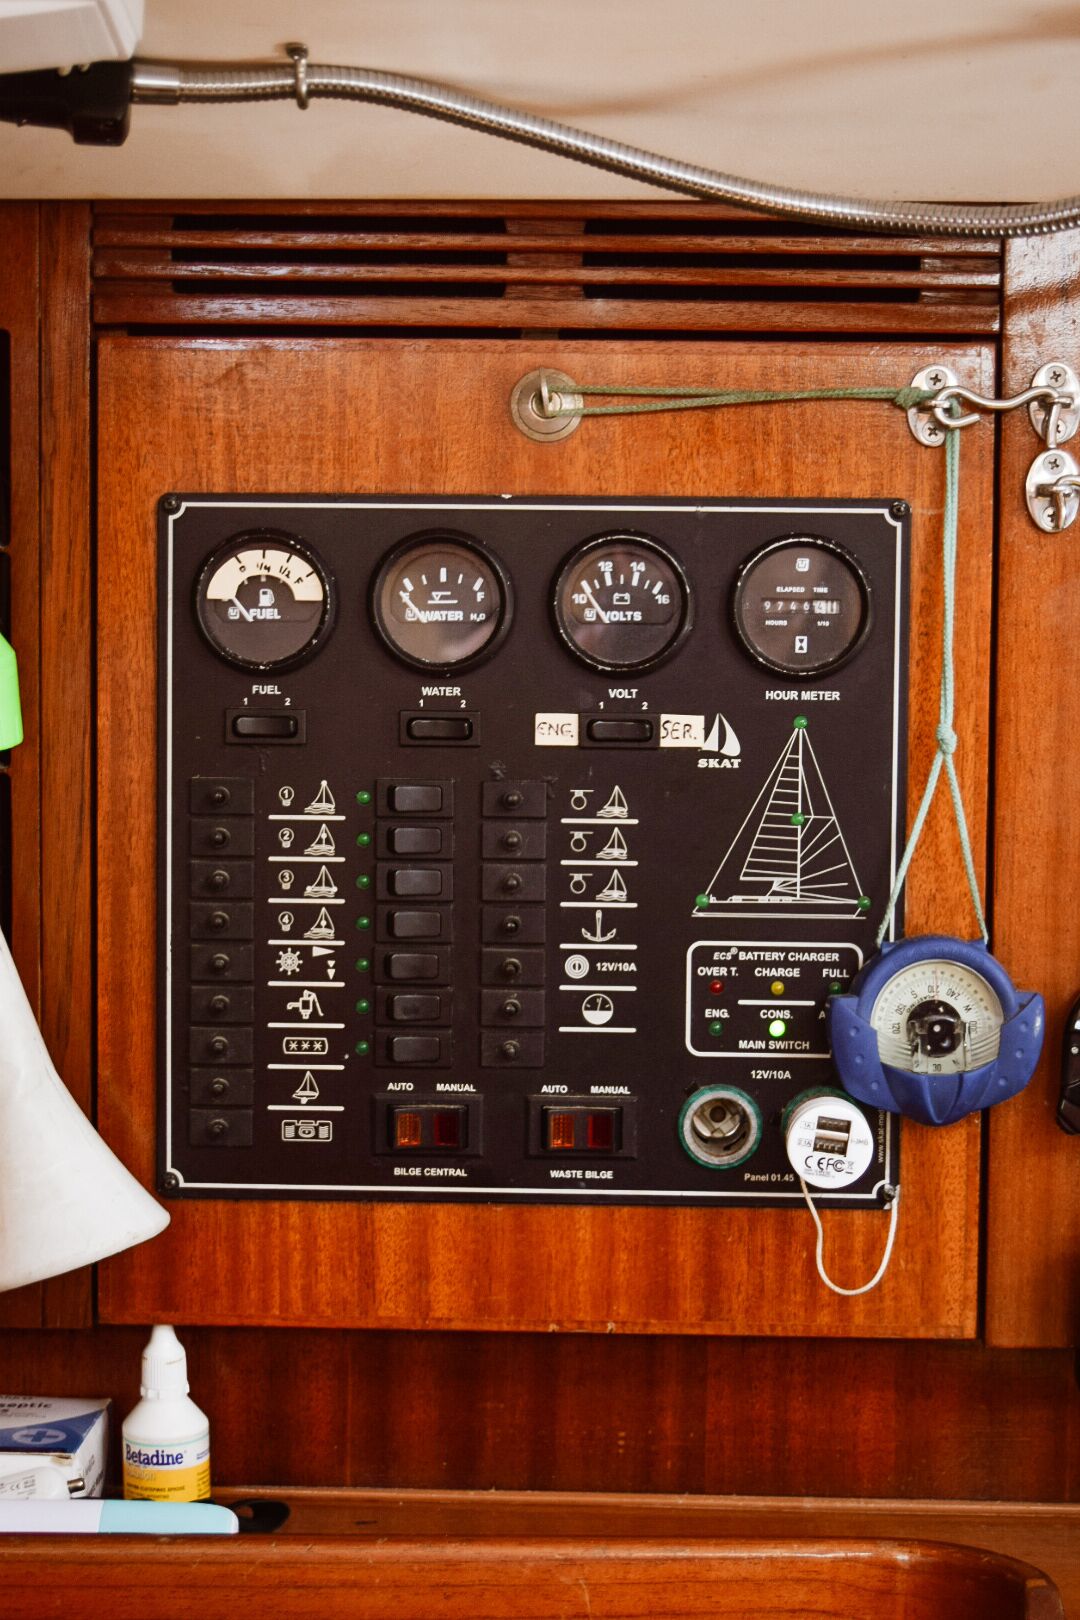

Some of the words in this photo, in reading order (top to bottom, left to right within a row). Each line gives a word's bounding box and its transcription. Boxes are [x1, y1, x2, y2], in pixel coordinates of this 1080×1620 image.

[598, 561, 613, 571] 12
[630, 561, 645, 571] 14
[476, 591, 485, 602] F
[572, 593, 588, 604] 10
[655, 594, 670, 604] 16
[248, 608, 282, 619] FUEL
[420, 610, 464, 621] WATER
[603, 611, 642, 621] VOLTS
[252, 684, 282, 695] FUEL
[421, 686, 462, 696] WATER
[608, 688, 638, 699] VOLT
[765, 690, 798, 700] HOUR
[801, 691, 840, 700] METER
[243, 697, 248, 706] 1
[284, 697, 291, 706] 2
[418, 698, 424, 708] 1
[460, 699, 467, 708] 2
[598, 701, 604, 710] 1
[641, 701, 648, 710] 2
[697, 758, 742, 768] SKAT
[739, 951, 785, 961] BATTERY
[788, 952, 839, 962] CHARGER
[596, 962, 637, 973] 12V/10A
[697, 967, 727, 976] OVER
[730, 967, 739, 976] T.
[754, 968, 801, 978] CHARGE
[822, 968, 850, 978] FULL
[704, 1009, 731, 1018] ENG.
[760, 1010, 794, 1019] CONS.
[738, 1040, 766, 1049] MAIN
[769, 1041, 810, 1050] SWITCH
[750, 1070, 792, 1080] 12V/10A
[387, 1082, 414, 1091] AUTO
[436, 1083, 477, 1092] MANUAL
[541, 1085, 568, 1094] AUTO
[590, 1085, 631, 1094] MANUAL
[394, 1167, 422, 1176] BILGE
[424, 1168, 467, 1177] CENTRAL
[550, 1169, 583, 1178] WASTE
[585, 1170, 614, 1179] BILGE
[744, 1172, 769, 1182] Panel
[771, 1172, 795, 1182] 01.45
[125, 1443, 184, 1466] Betadine
